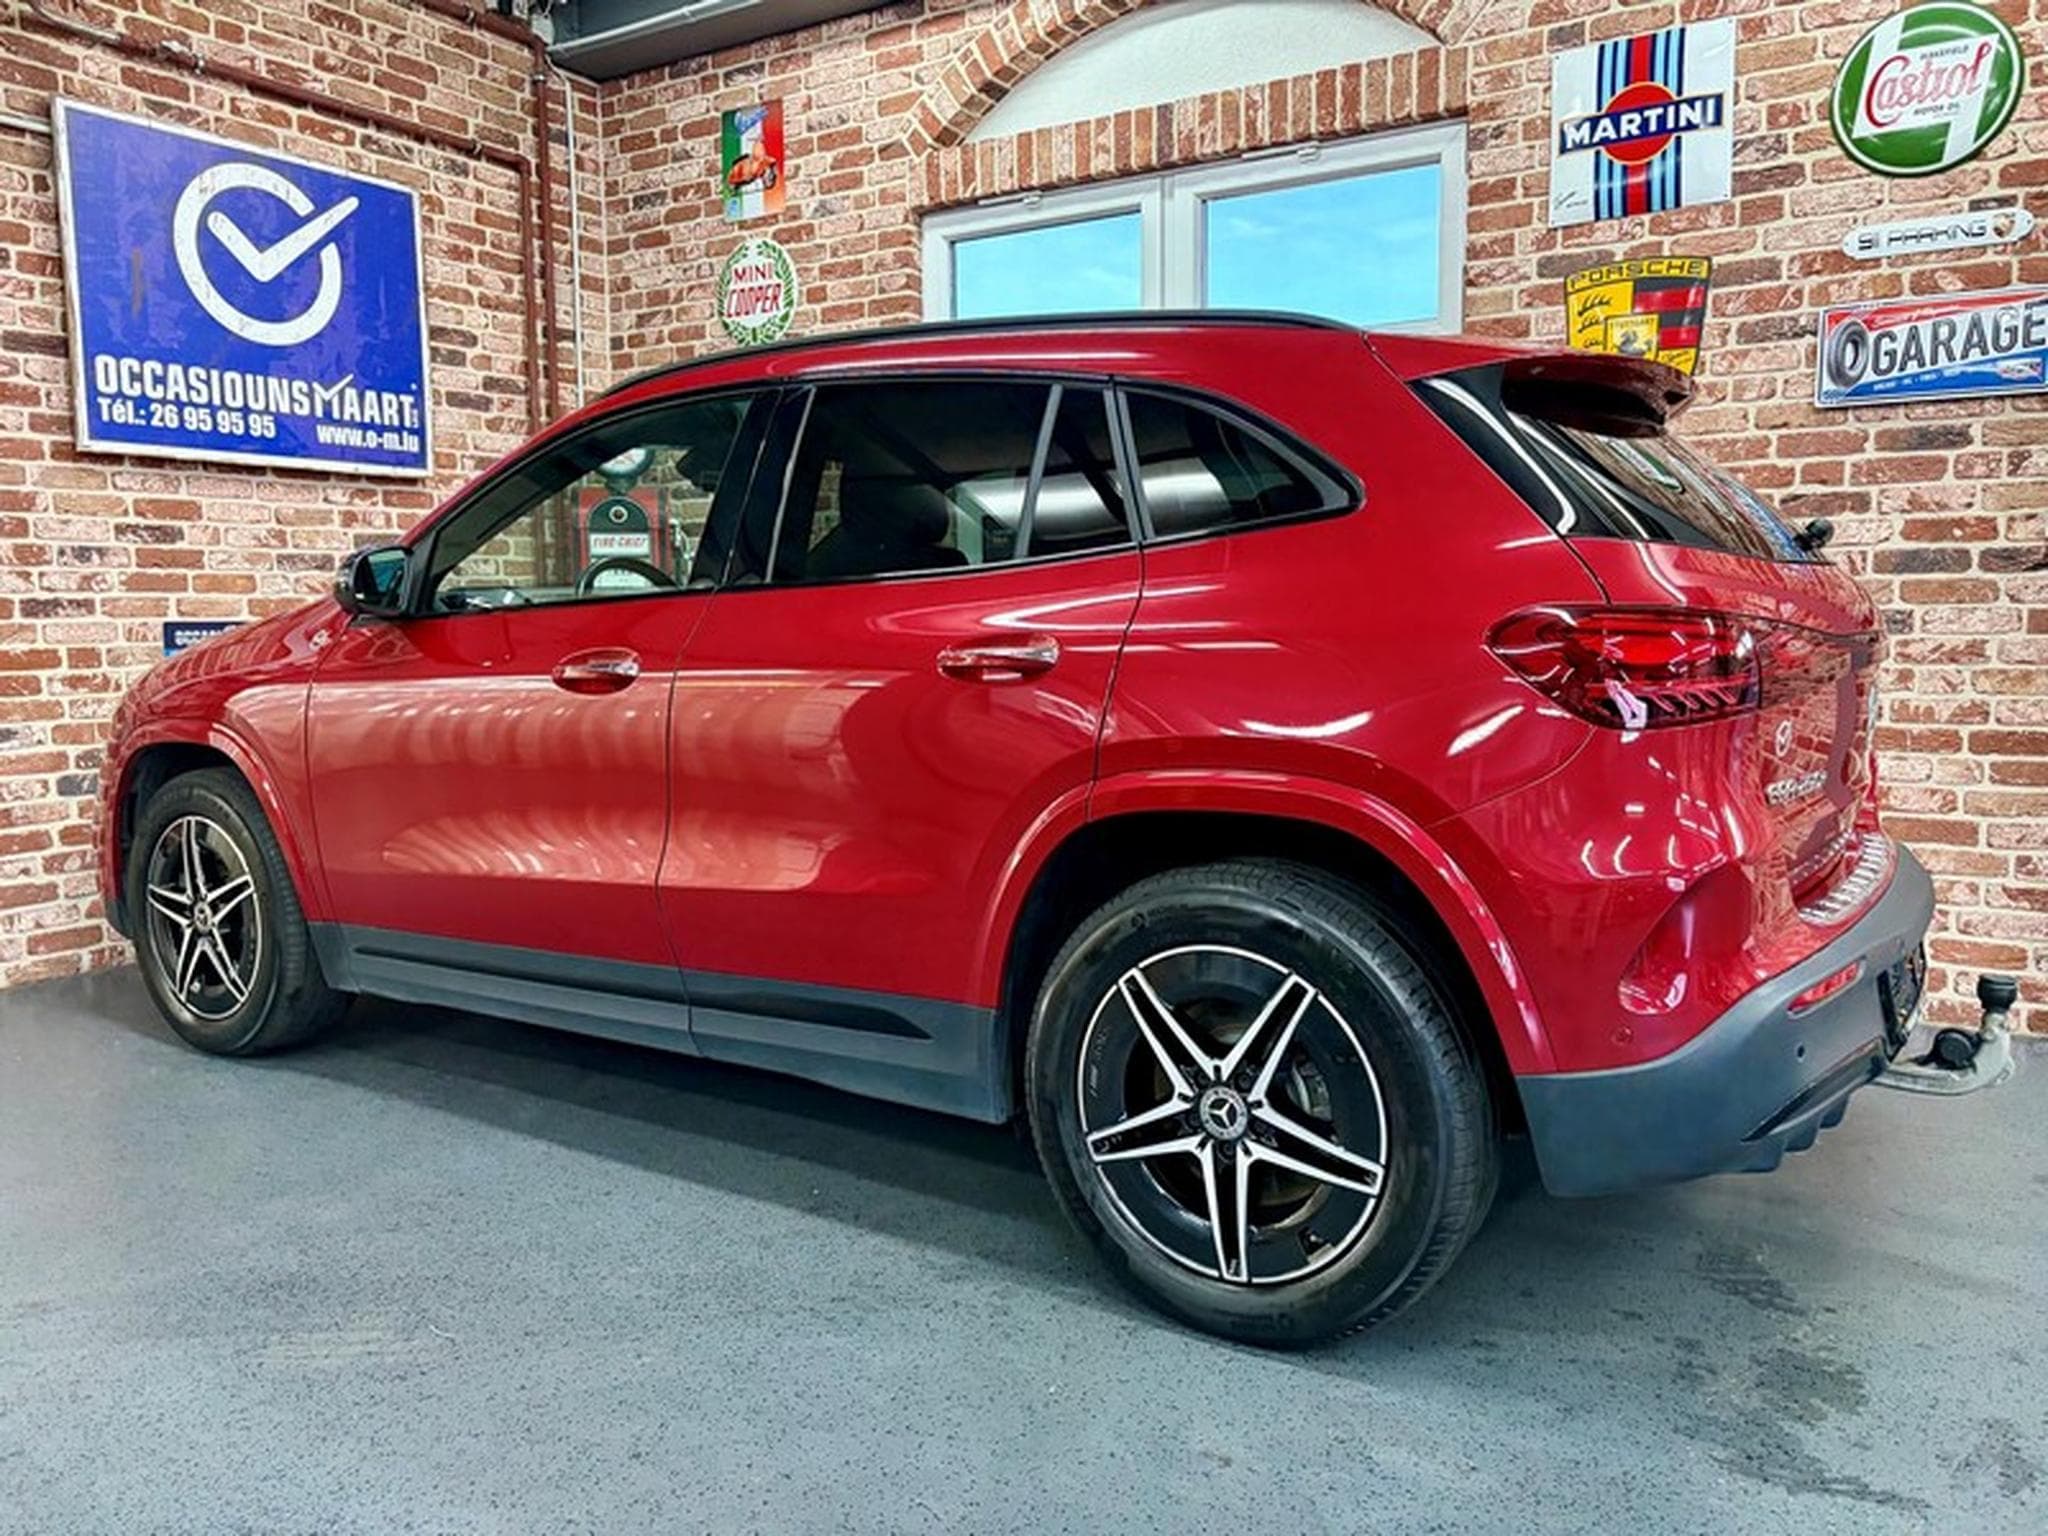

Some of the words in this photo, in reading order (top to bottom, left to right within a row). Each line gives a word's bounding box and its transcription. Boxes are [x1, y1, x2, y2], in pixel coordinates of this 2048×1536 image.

[1864, 39, 1992, 128] Castrol
[1563, 98, 1715, 149] MARTINI
[1886, 219, 1987, 246] PARKING
[733, 264, 773, 285] MINI
[1569, 260, 1702, 289] PORSCHE
[725, 283, 782, 318] COOPER
[1871, 299, 2048, 377] GARAGE
[94, 355, 415, 428] OCCASIOUNSMAART
[151, 403, 178, 429] 26
[183, 406, 212, 432] 95
[217, 409, 245, 435] 95
[249, 412, 276, 439] 95
[316, 424, 420, 452] www.o-m.lu
